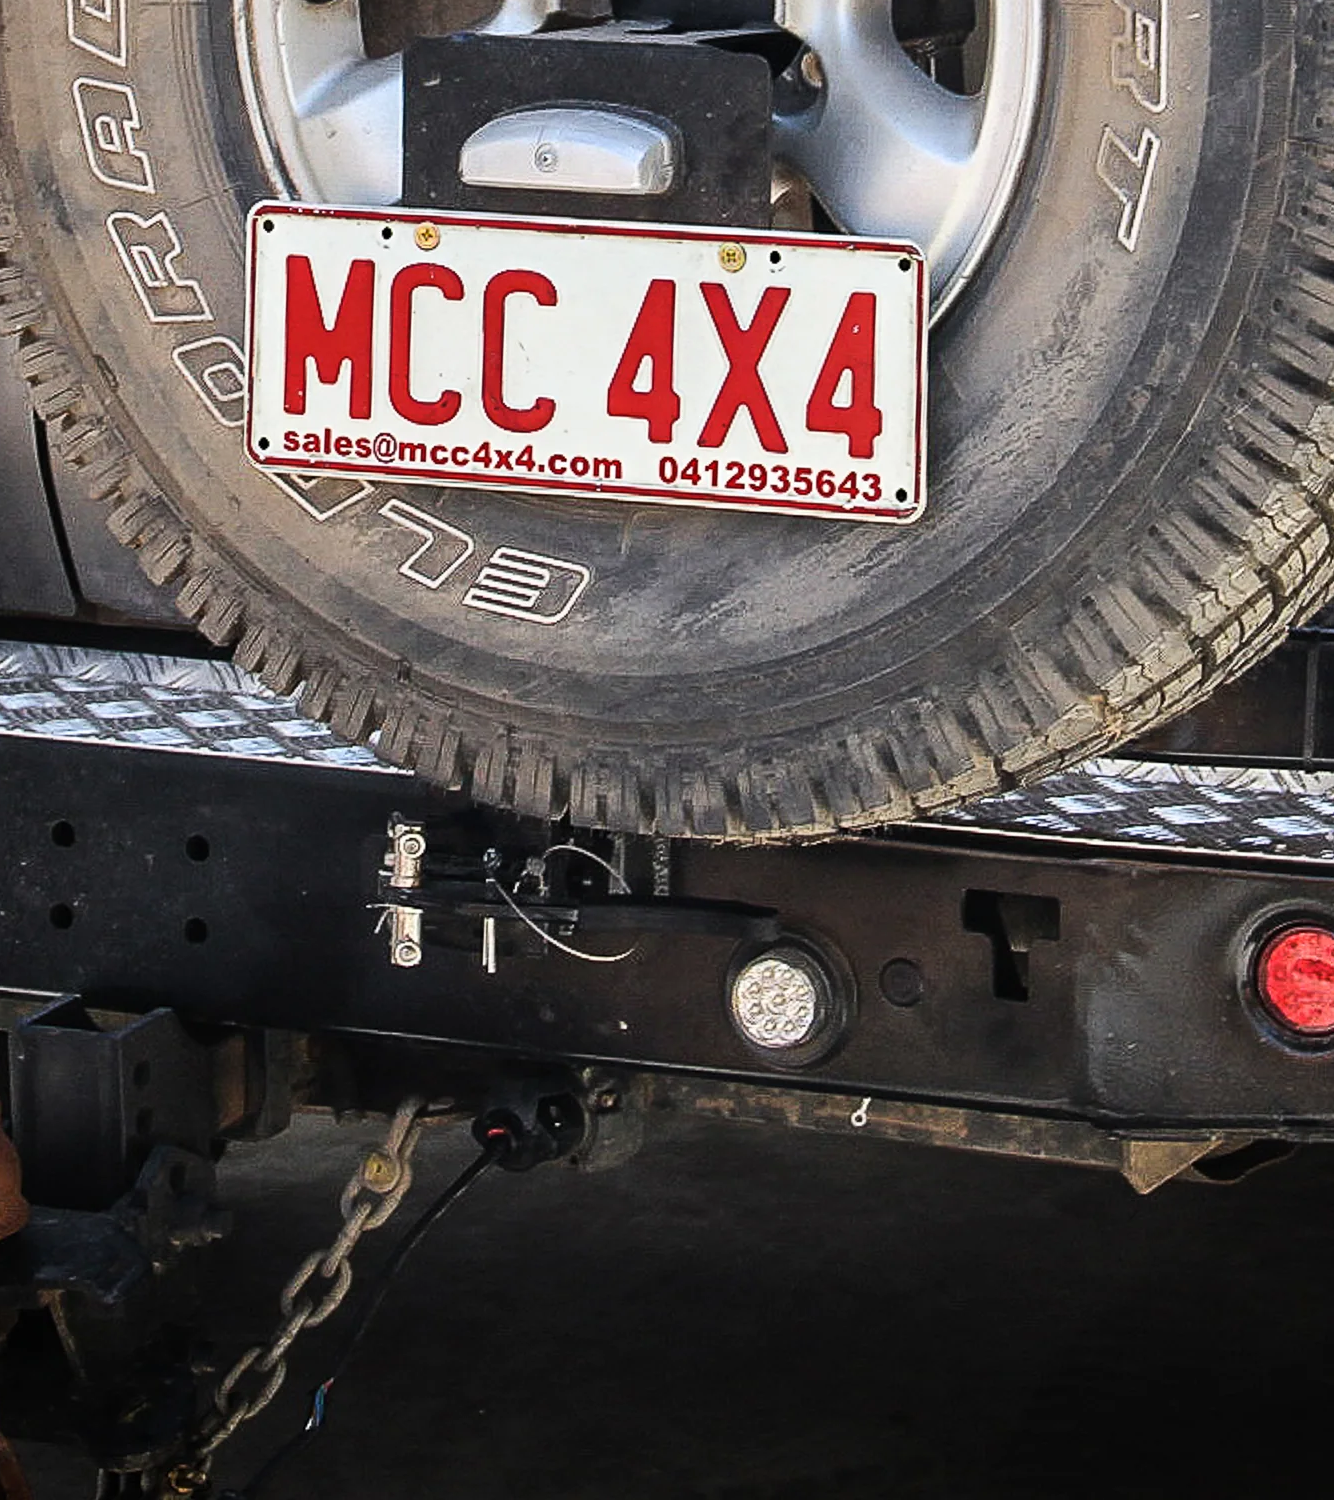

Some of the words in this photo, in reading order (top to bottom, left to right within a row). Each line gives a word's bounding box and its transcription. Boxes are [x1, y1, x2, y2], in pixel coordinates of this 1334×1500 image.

[283, 253, 558, 434] MCC
[606, 277, 884, 460] 4X4
[282, 427, 623, 481] sales@mcc4x4.com
[657, 455, 884, 502] 0412935643
